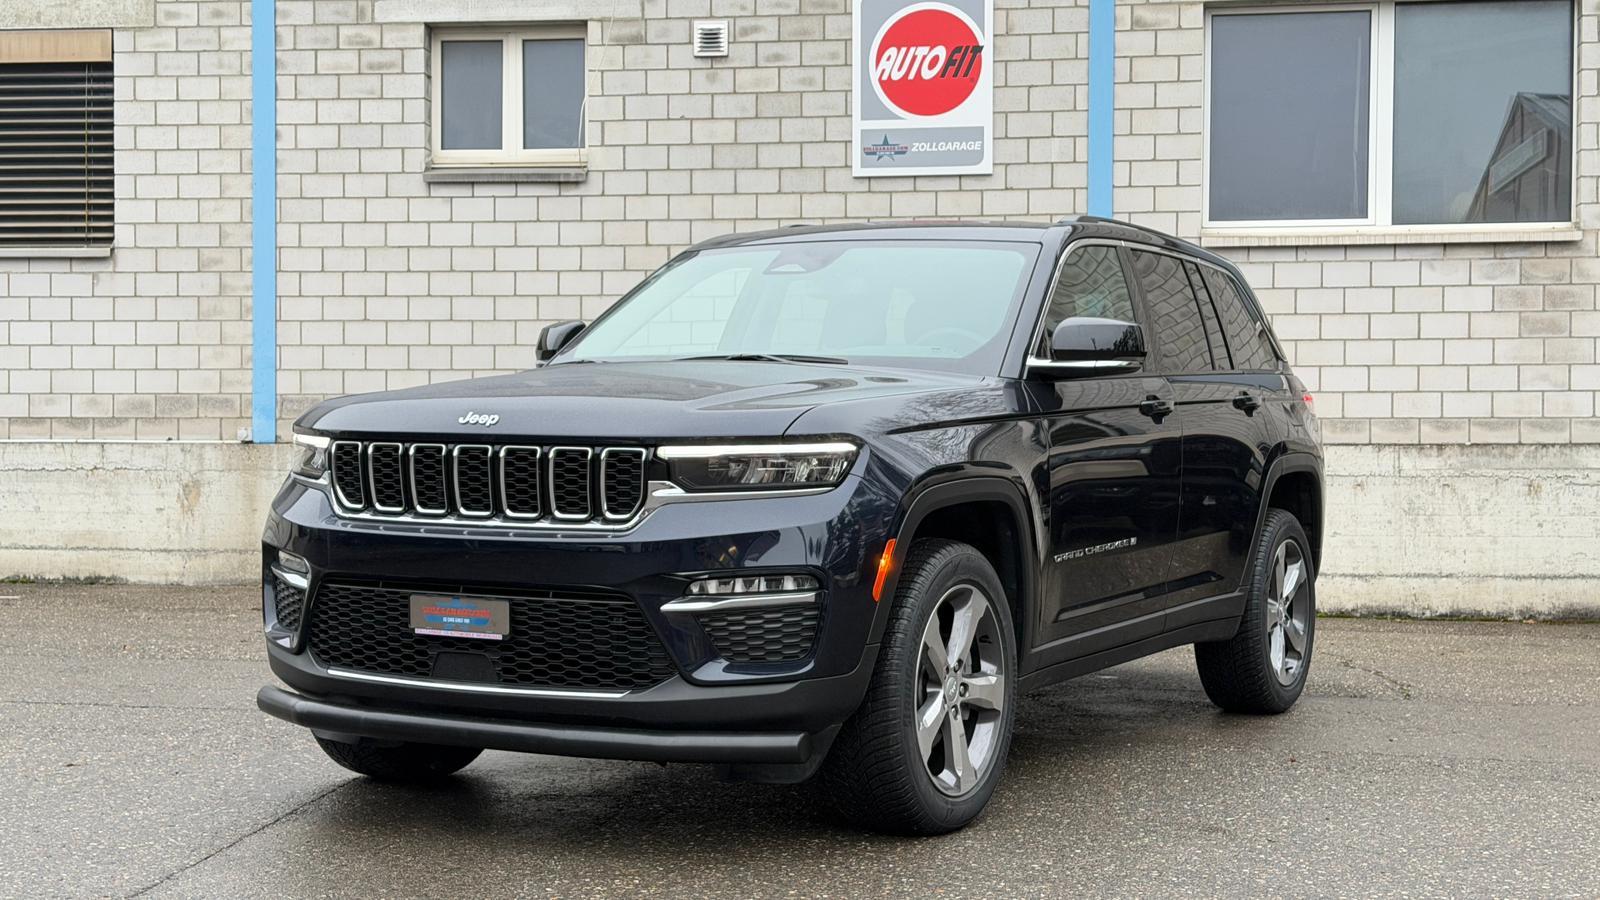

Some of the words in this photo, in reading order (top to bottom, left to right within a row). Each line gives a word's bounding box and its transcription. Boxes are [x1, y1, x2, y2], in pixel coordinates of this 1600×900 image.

[877, 45, 984, 81] AUTOFIT
[911, 141, 982, 152] ZOLLGARAGE
[458, 411, 499, 427] Jeep
[1054, 549, 1084, 563] GRAND
[1085, 539, 1130, 555] CHEROKEE
